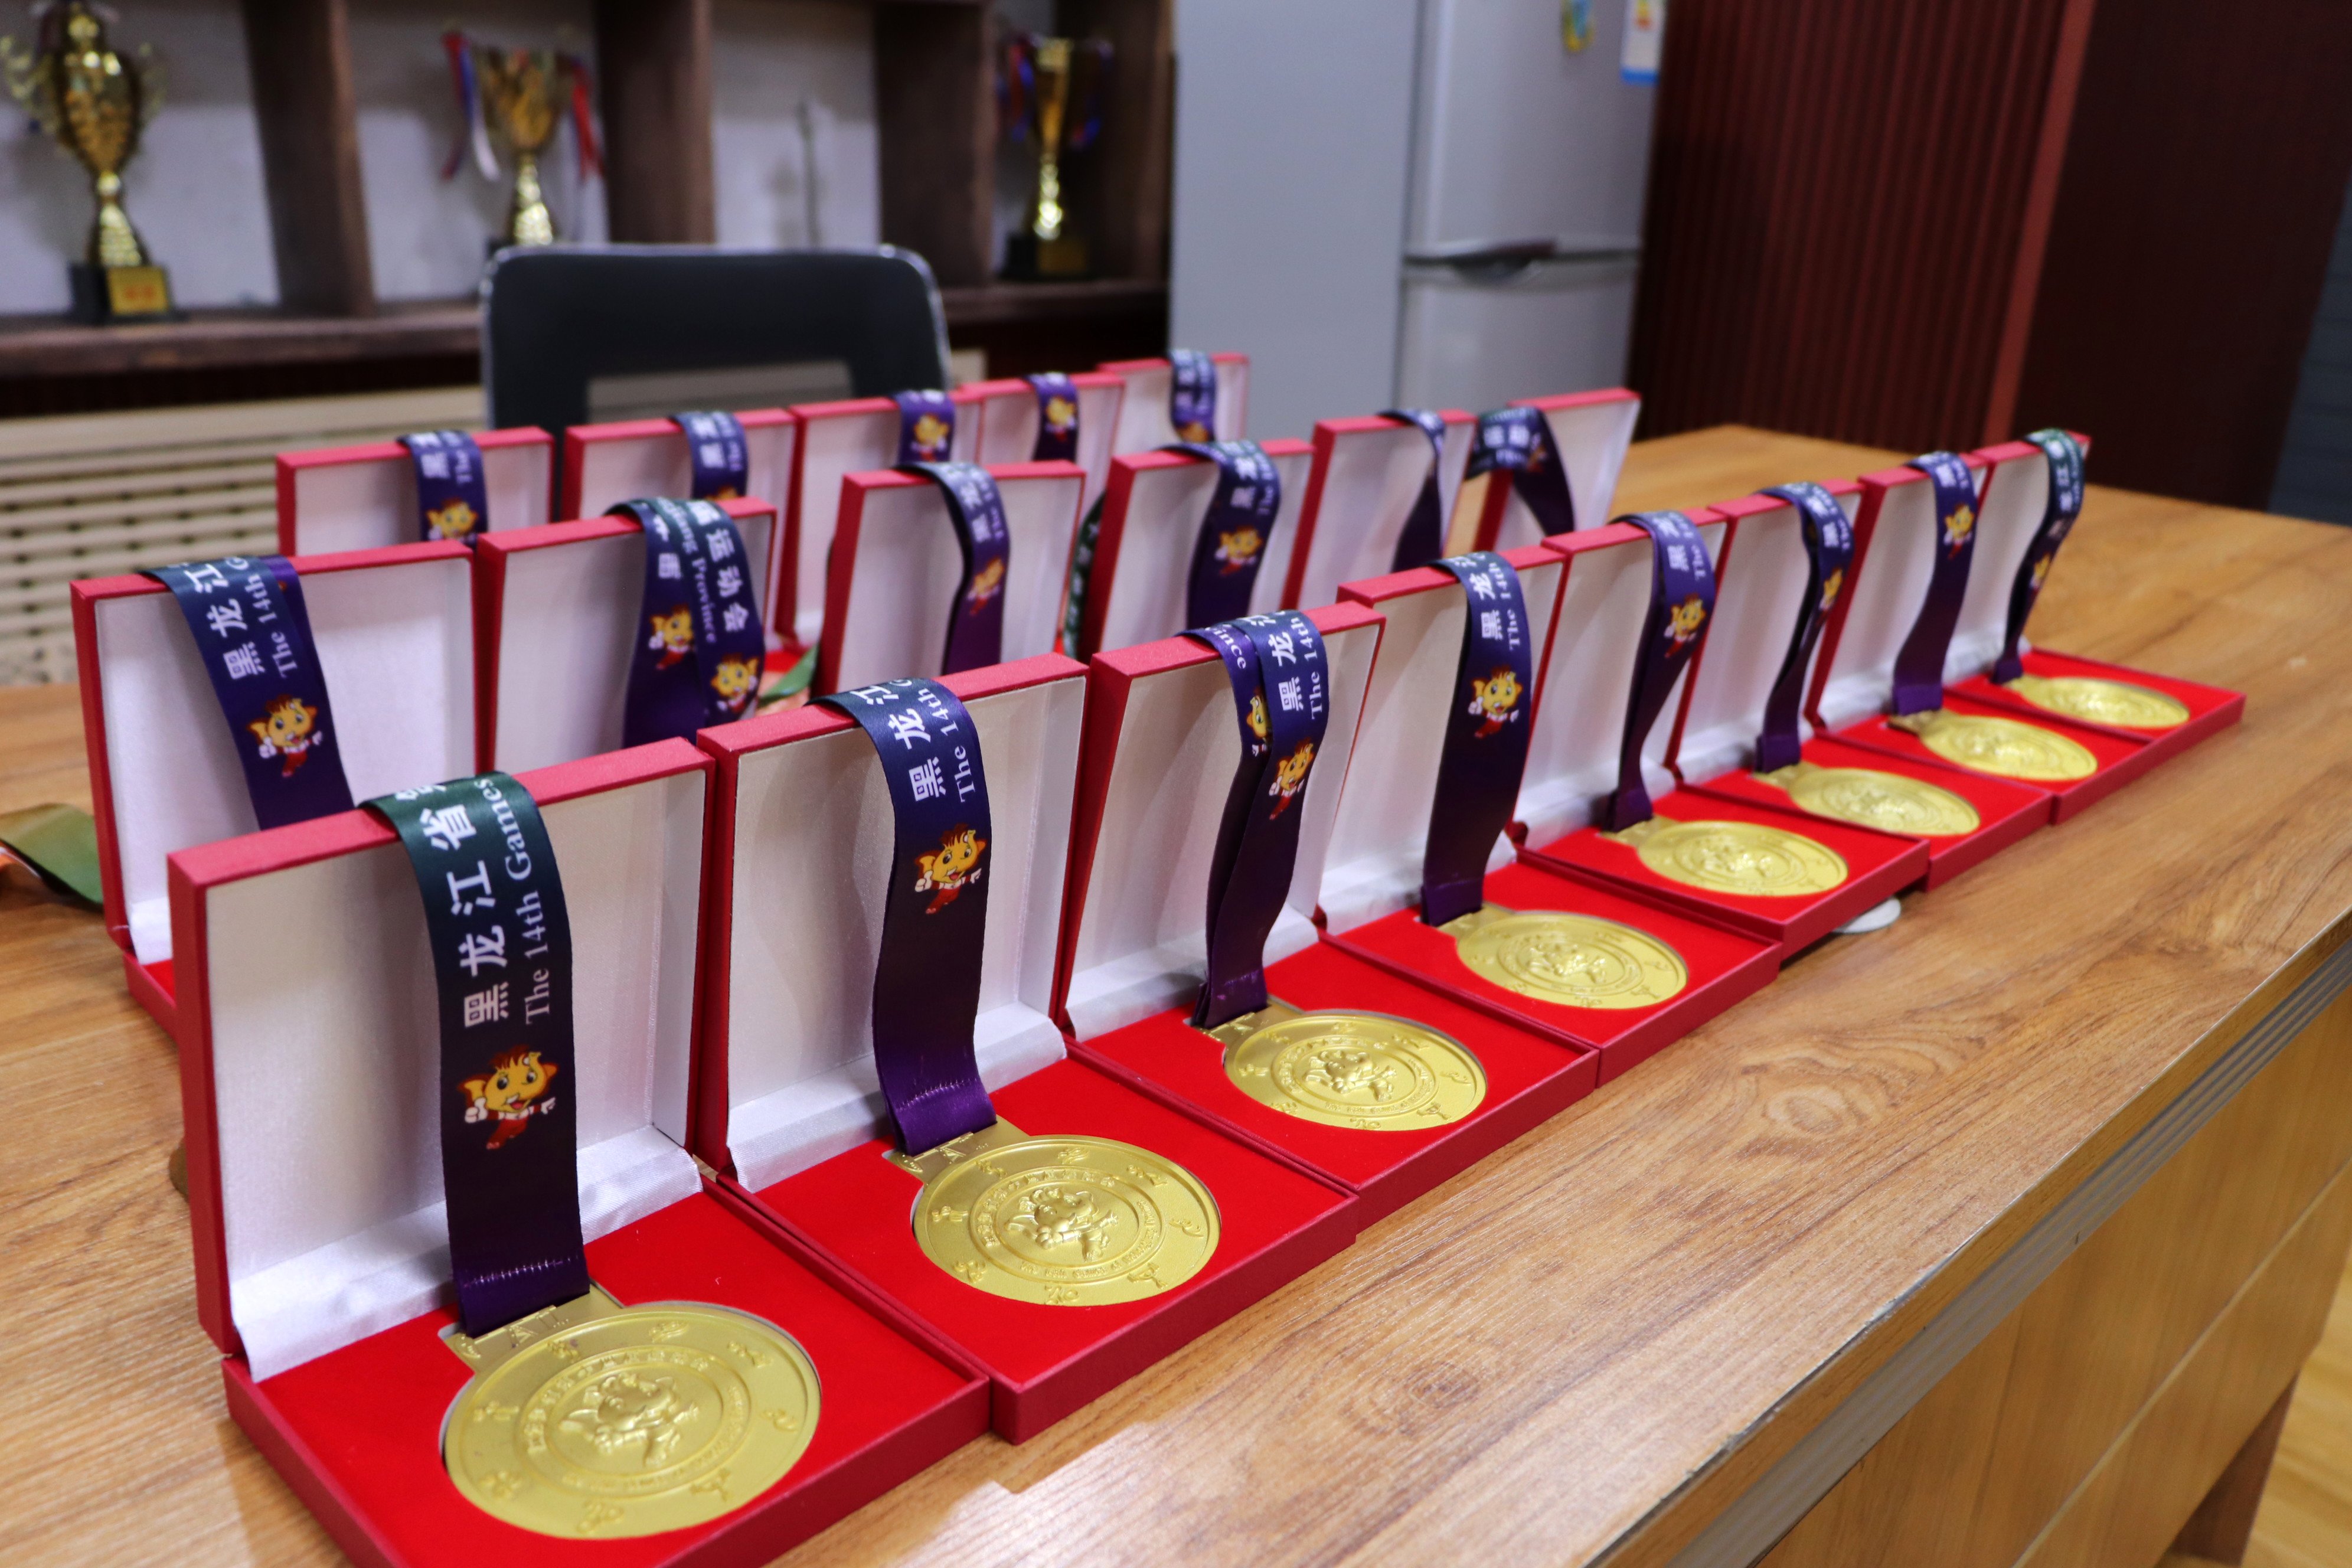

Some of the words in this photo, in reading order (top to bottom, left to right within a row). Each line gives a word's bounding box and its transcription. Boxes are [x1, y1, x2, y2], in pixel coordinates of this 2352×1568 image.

[167, 562, 266, 680] 黑龙江
[244, 573, 277, 623] 14th
[271, 631, 298, 678] The
[1291, 617, 1318, 662] 14th
[1507, 609, 1520, 651] The
[917, 688, 959, 736] 14th
[1308, 671, 1323, 720] The
[850, 685, 946, 802] 黑龙江
[953, 745, 976, 803] The
[474, 778, 531, 881] Games
[515, 890, 549, 959] 14th
[524, 967, 550, 1025] The
